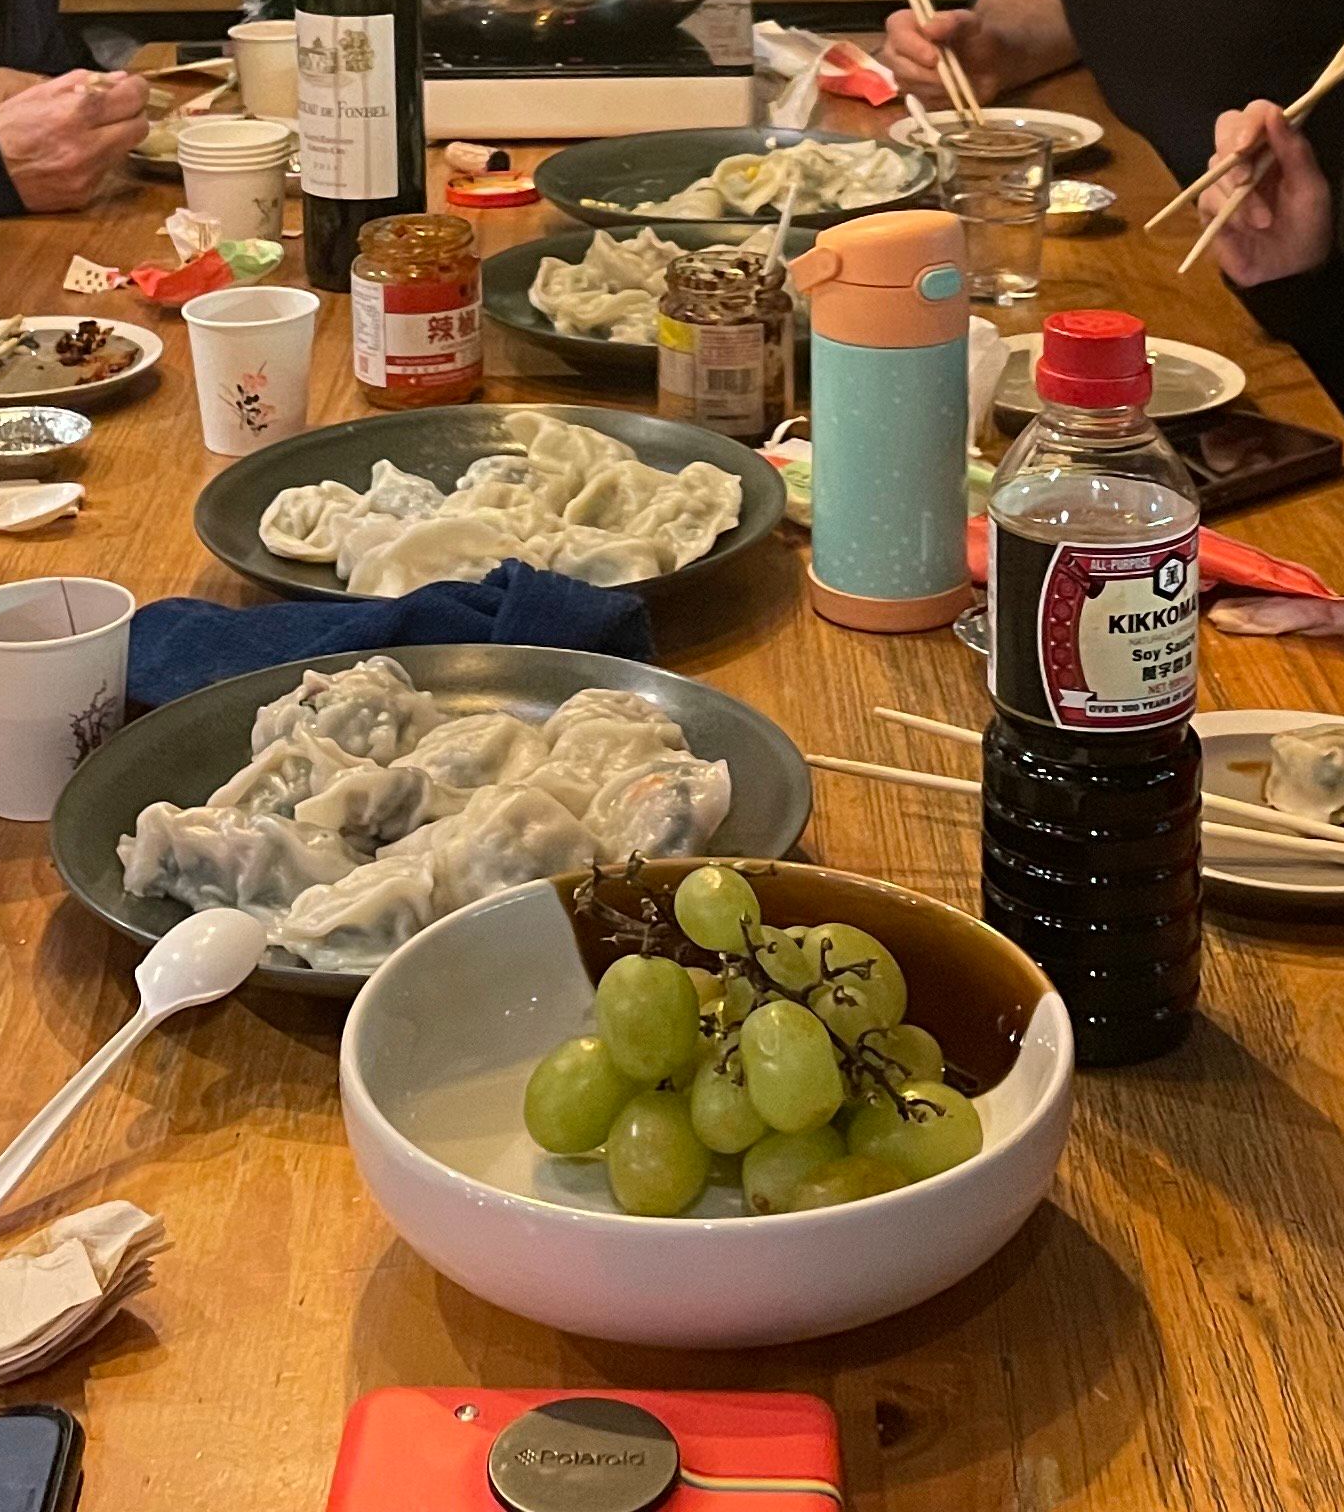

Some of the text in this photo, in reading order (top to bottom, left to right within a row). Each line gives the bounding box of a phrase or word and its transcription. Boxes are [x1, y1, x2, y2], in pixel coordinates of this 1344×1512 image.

[1131, 648, 1162, 662] Soy
[1088, 704, 1119, 714] OVER
[539, 1449, 646, 1466] Polaroid
